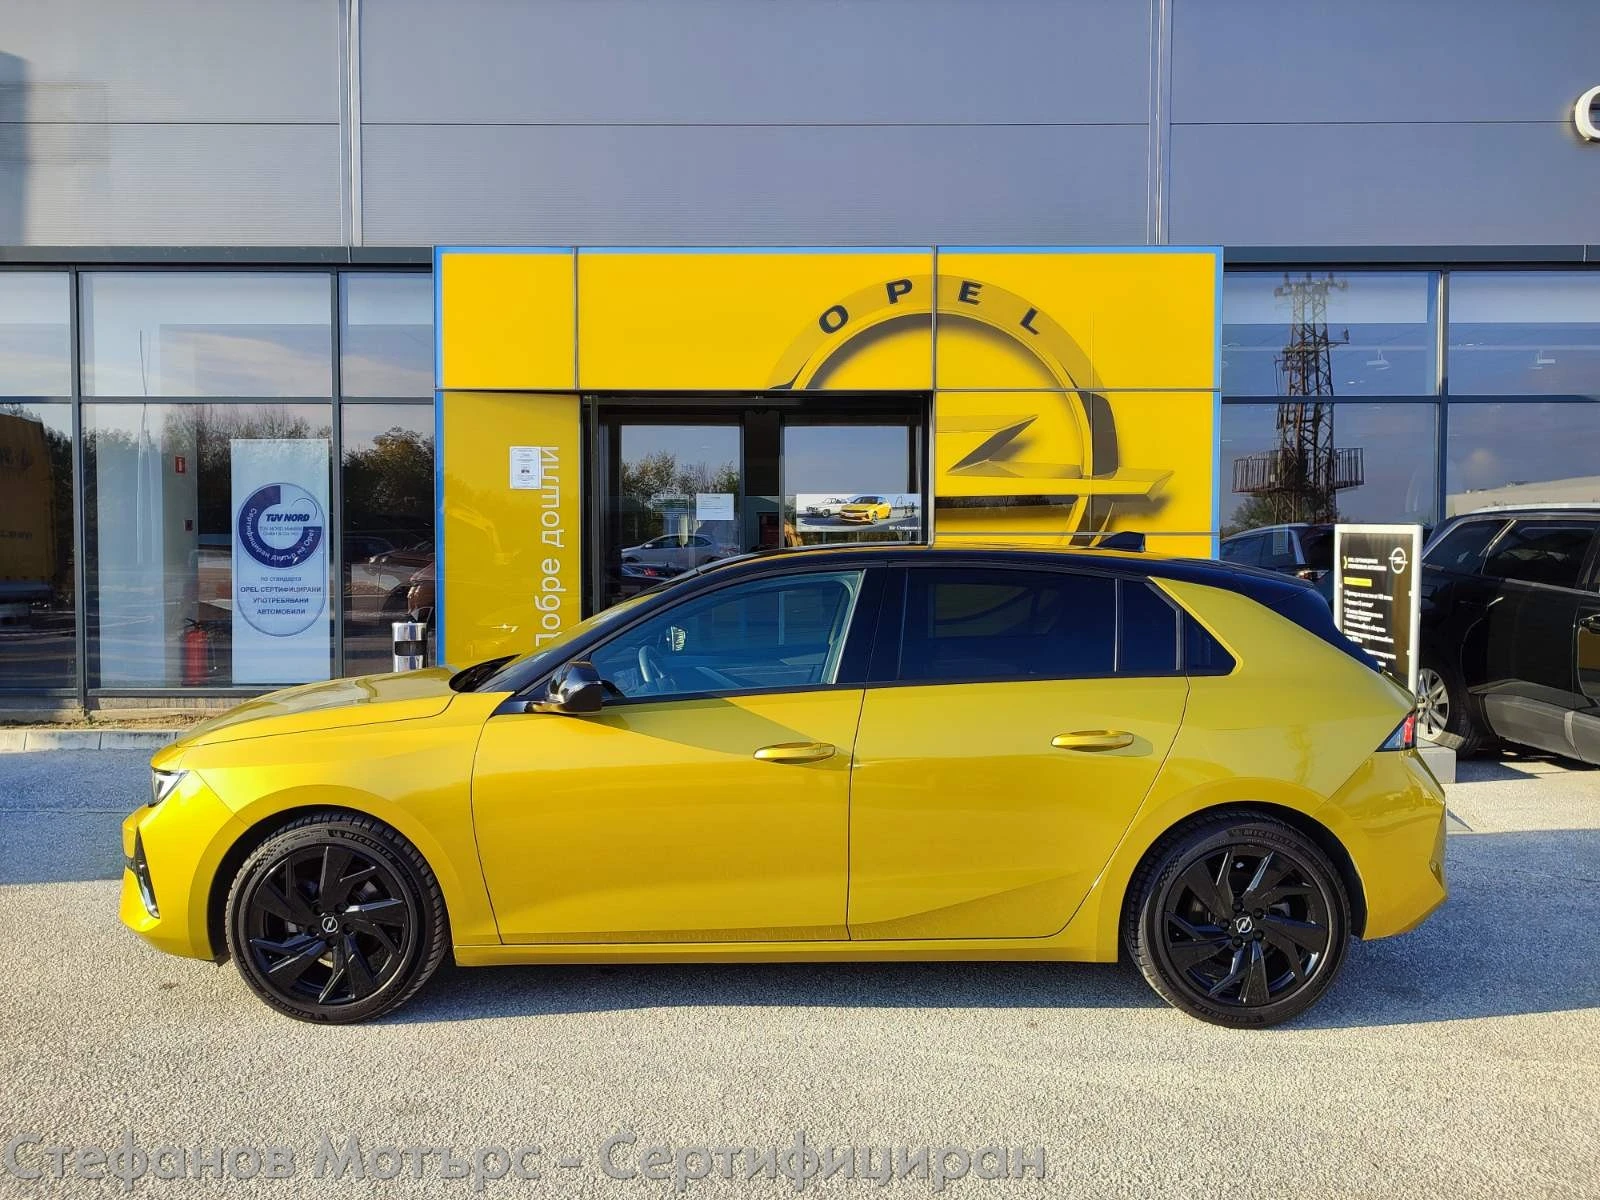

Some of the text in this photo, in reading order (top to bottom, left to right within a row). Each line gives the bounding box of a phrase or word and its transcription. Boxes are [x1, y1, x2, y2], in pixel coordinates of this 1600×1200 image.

[818, 279, 1041, 335] OPEL
[283, 513, 310, 522] NORD
[541, 446, 565, 548] дошли
